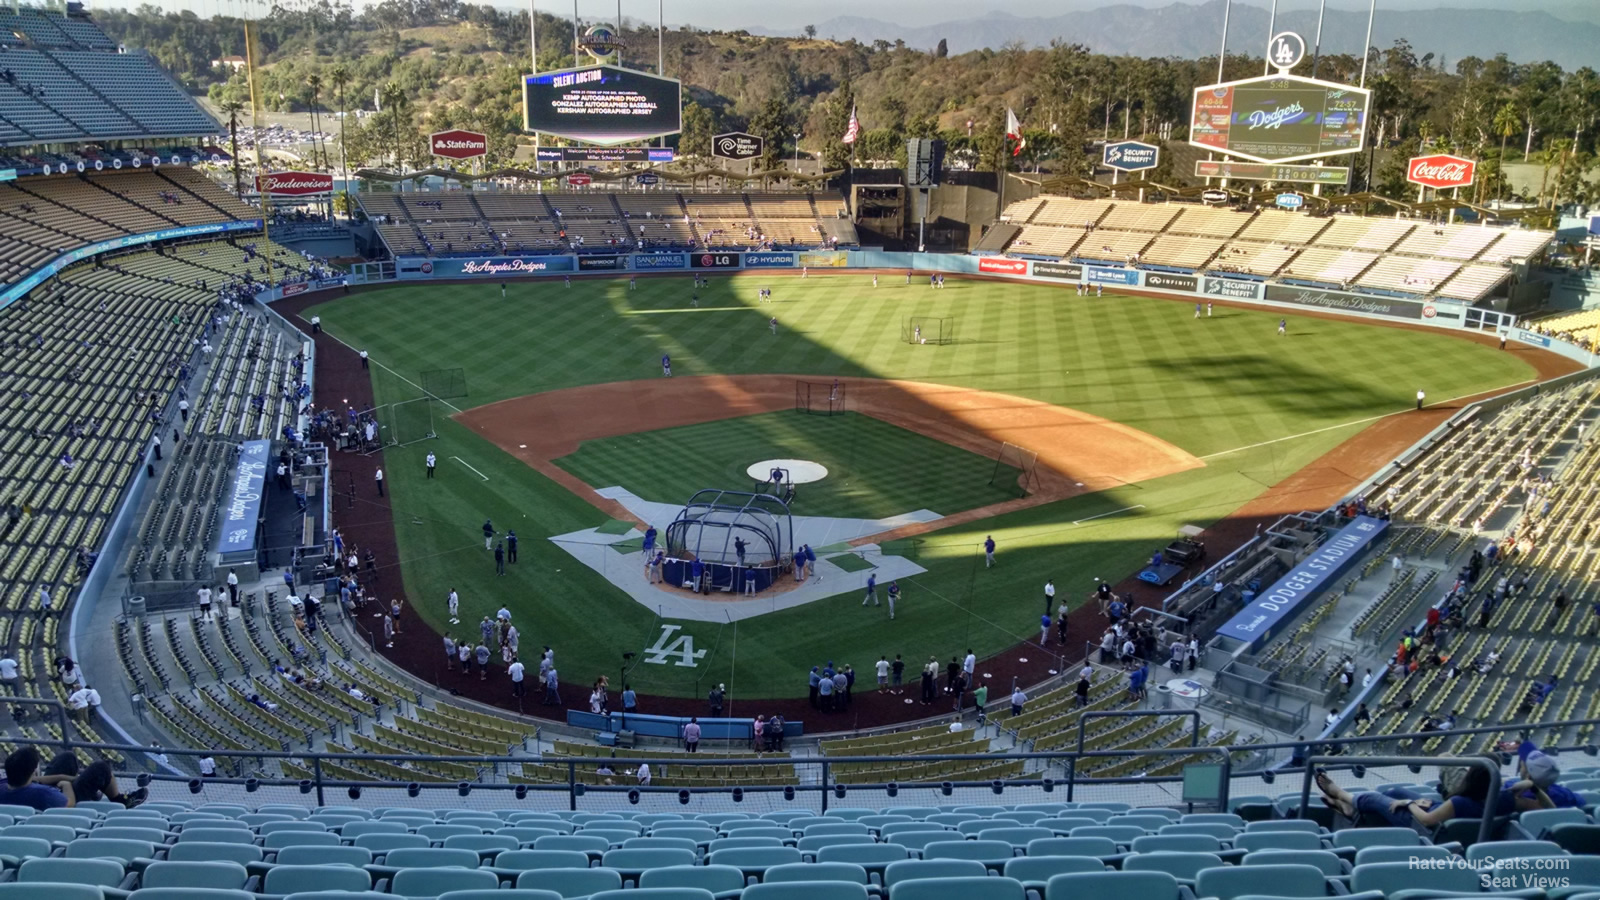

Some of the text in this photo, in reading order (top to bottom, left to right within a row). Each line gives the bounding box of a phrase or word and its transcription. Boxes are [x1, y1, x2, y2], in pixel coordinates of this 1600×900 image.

[1276, 38, 1293, 63] LA
[553, 70, 601, 88] SILENT AUCTION
[1249, 101, 1304, 130] Dodgers
[1413, 162, 1469, 181] Coca-Cola
[260, 178, 331, 190] Budweiser
[462, 259, 546, 274] Los Angeles Dodgers
[716, 256, 730, 264] LG
[1222, 288, 1250, 297] BENEFIT
[1223, 282, 1256, 290] SECURITY
[1295, 291, 1390, 313] Los Angeles Dodgers
[1260, 534, 1362, 612] DODGER STADIUM
[644, 624, 707, 667] LA
